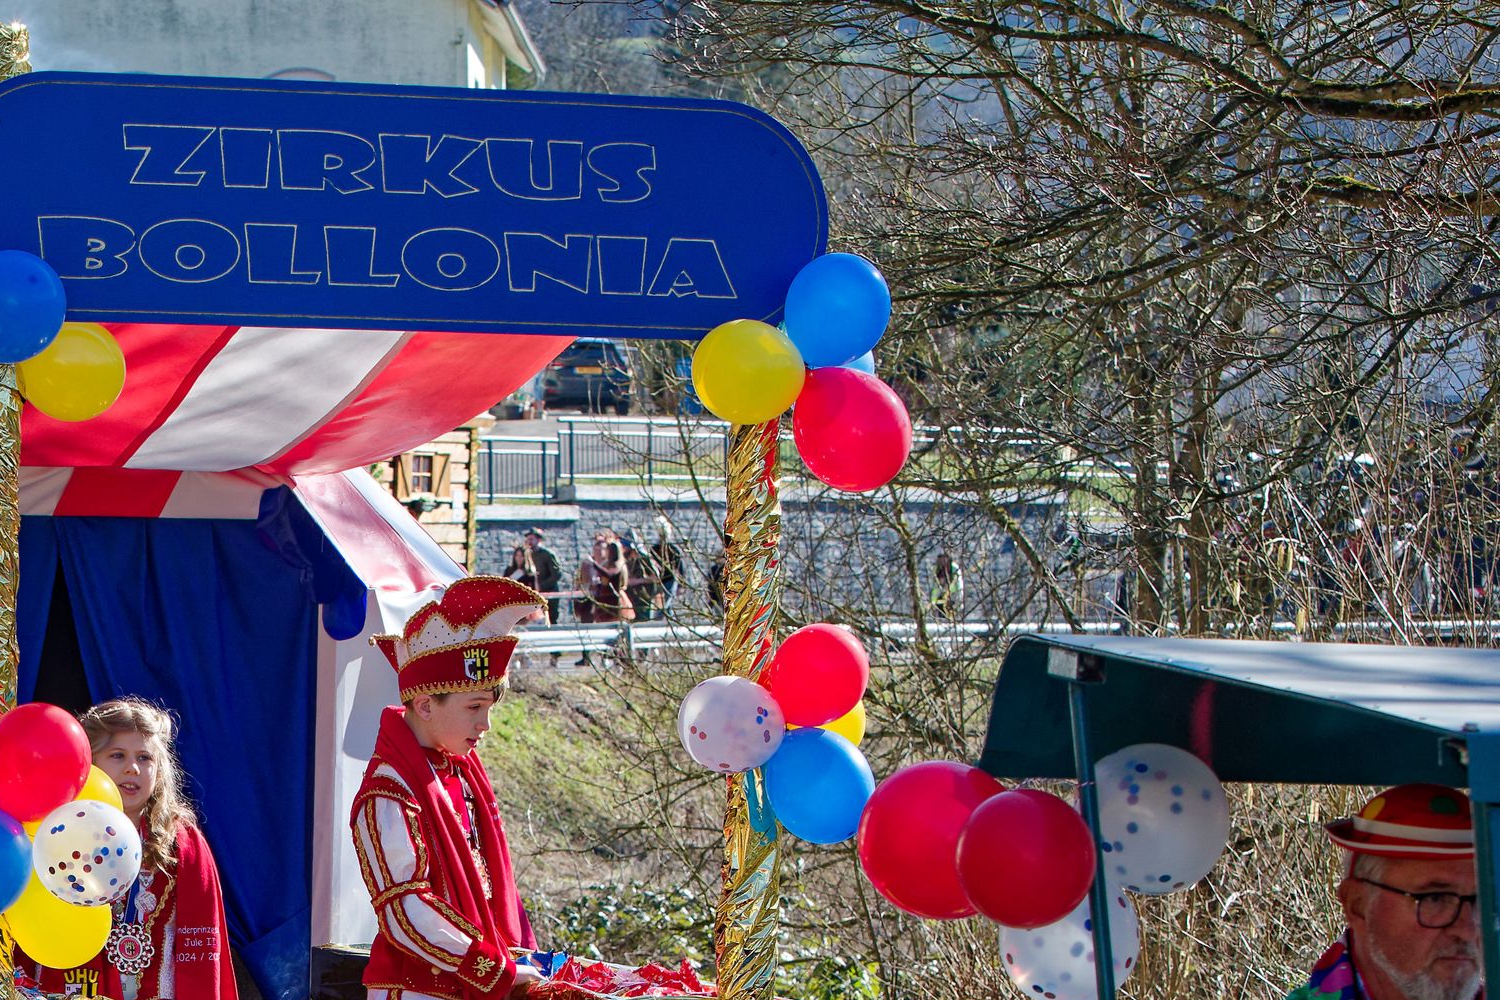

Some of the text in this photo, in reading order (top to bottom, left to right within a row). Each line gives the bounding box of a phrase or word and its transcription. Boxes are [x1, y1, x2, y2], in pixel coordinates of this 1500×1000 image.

[123, 124, 657, 202] ZIRKUS
[37, 214, 738, 300] BOLLONIA
[463, 648, 489, 659] UHU
[184, 937, 203, 947] Jule
[63, 969, 99, 983] UHU
